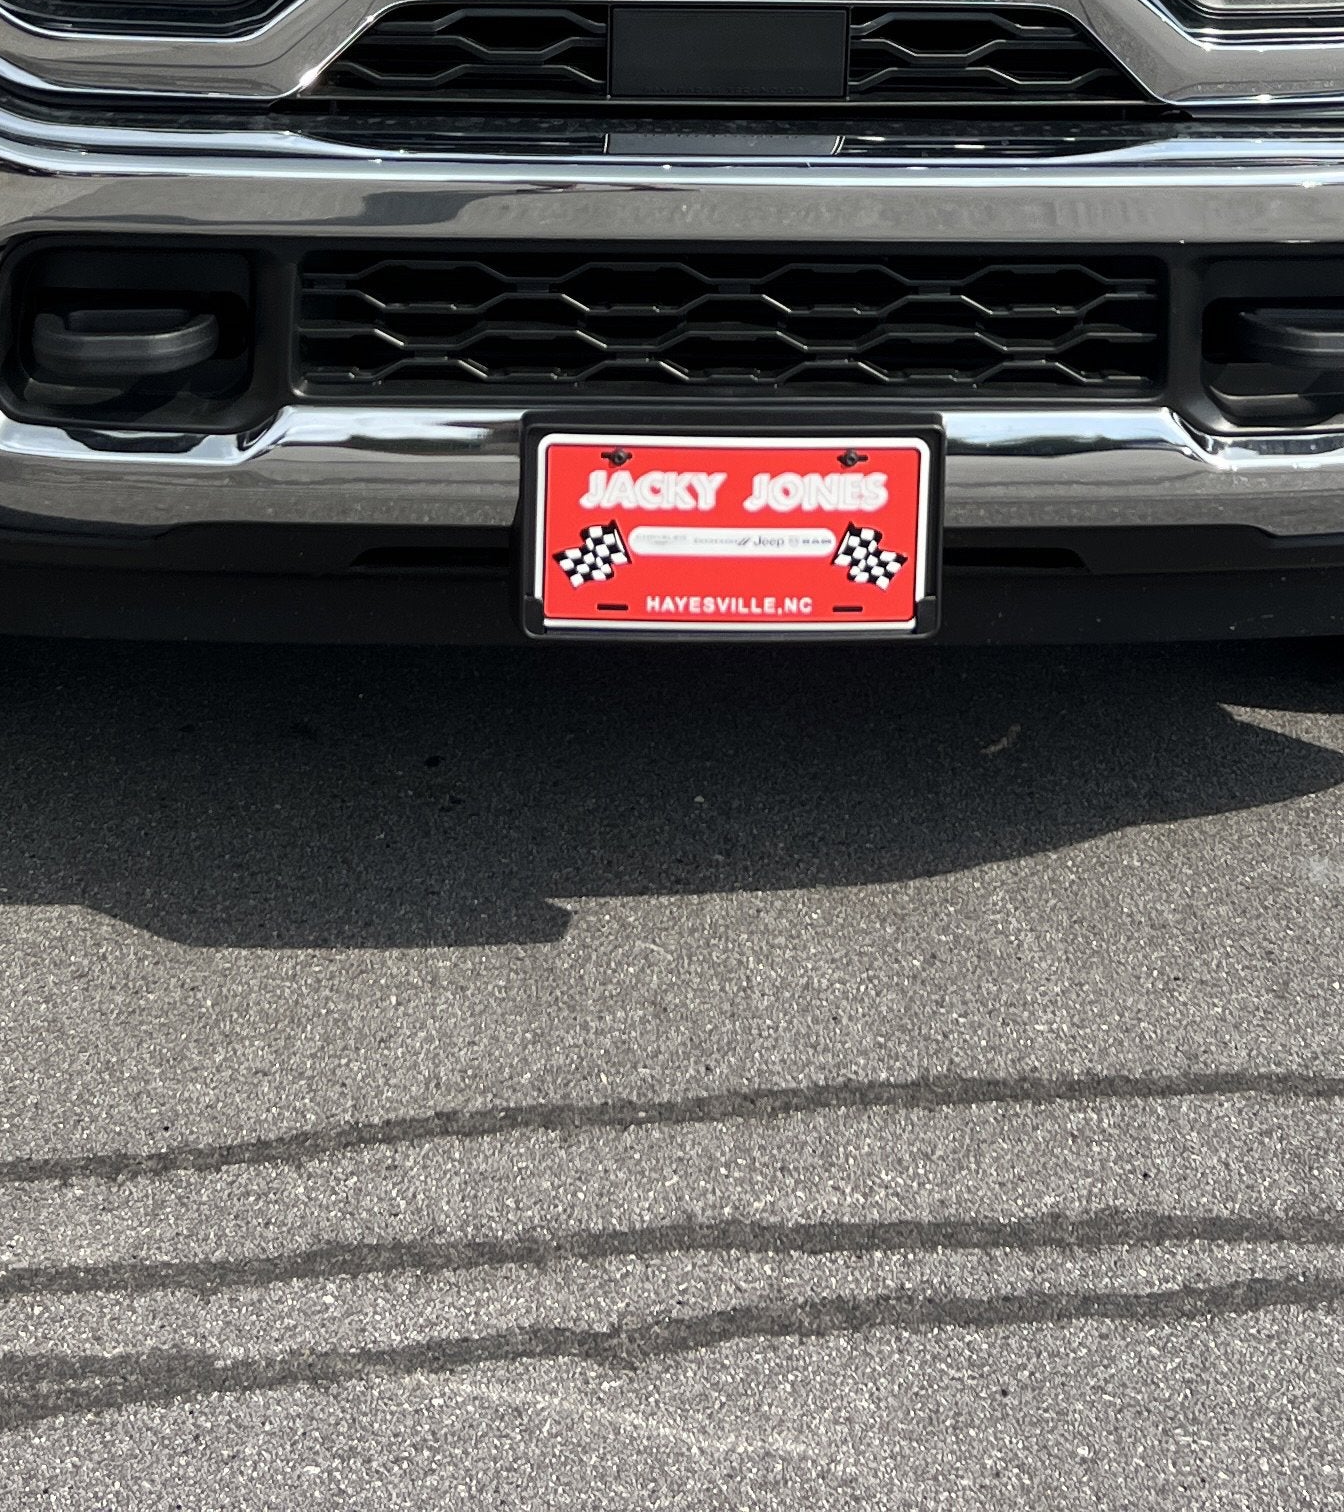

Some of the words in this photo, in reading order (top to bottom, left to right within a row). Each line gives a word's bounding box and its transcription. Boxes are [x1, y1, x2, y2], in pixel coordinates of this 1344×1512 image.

[579, 470, 727, 511] JACKY
[743, 472, 889, 512] JONES
[753, 535, 785, 548] Jeep
[646, 595, 813, 615] HAYESVILLE,NC
